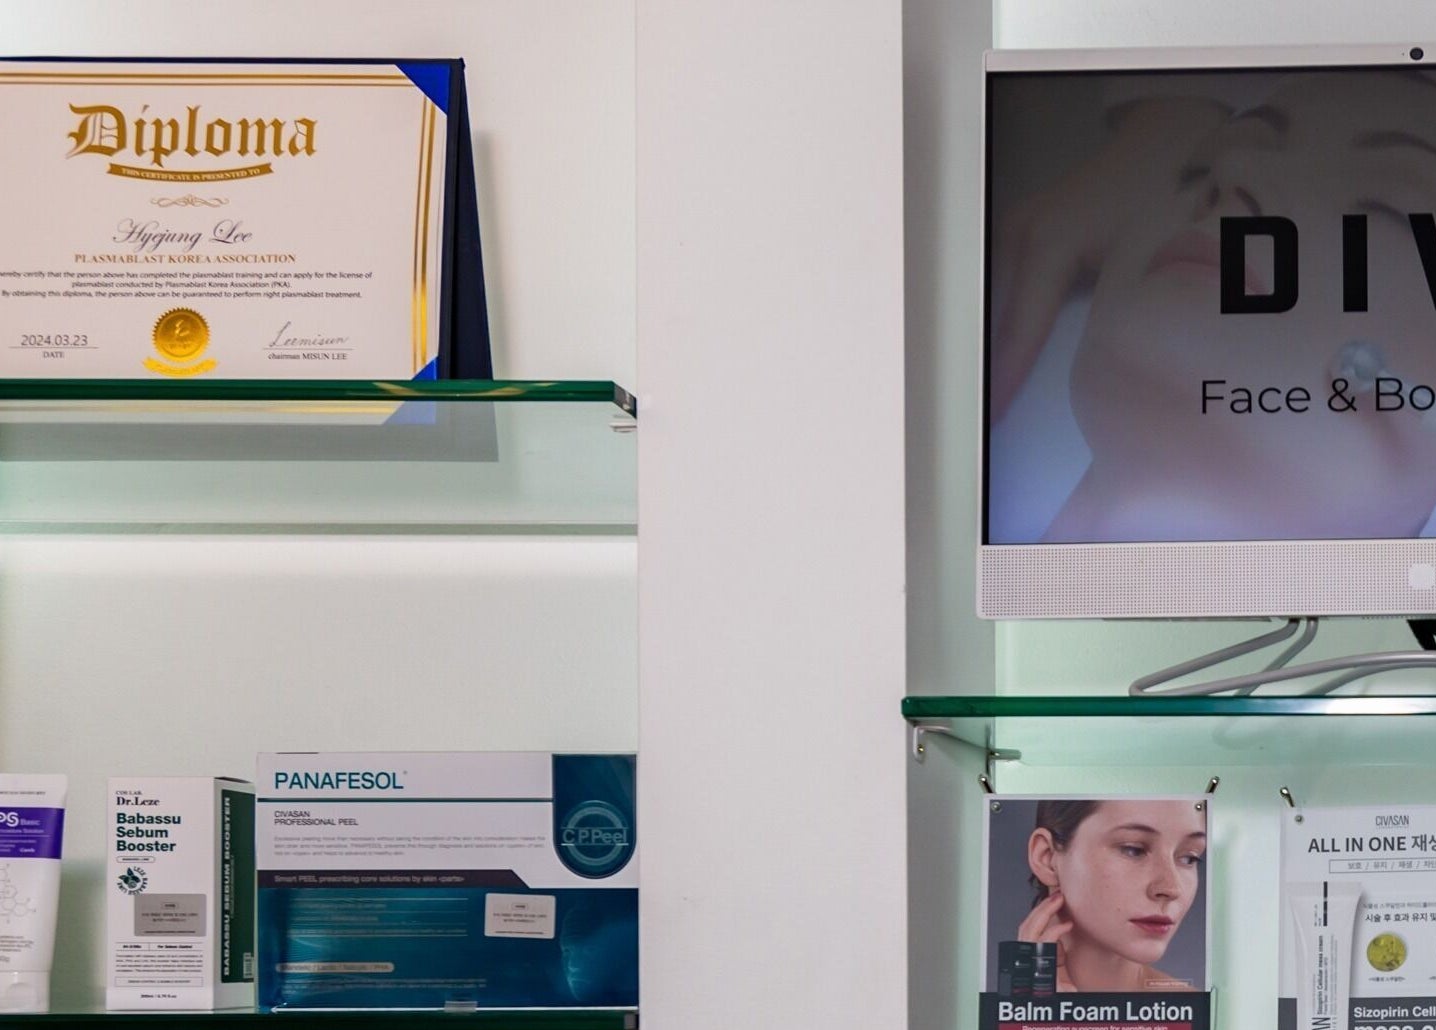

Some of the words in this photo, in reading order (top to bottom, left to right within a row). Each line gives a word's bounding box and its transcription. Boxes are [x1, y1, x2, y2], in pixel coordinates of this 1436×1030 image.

[66, 102, 319, 166] Diploma
[112, 218, 202, 252] Hyejung
[209, 219, 252, 244] Lee
[75, 254, 165, 264] PLASMABLAST
[168, 254, 211, 264] KOREA
[216, 254, 297, 264] ASSOCIATION
[20, 335, 88, 346] 2024.03.23
[43, 351, 64, 359] DATE
[1201, 379, 1310, 414] Face
[1328, 377, 1358, 413] &
[274, 771, 404, 790] PANAFESOL
[116, 796, 160, 806] Dr.Leze
[116, 812, 181, 825] Babassu
[274, 810, 310, 818] CIVASAN
[1376, 815, 1409, 825] CIVASAN
[223, 796, 231, 861] BOOSTER
[274, 818, 336, 826] PROFESSIONAL
[338, 818, 359, 826] PEEL
[116, 826, 168, 838] Sebum
[116, 840, 176, 852] Booster
[1308, 838, 1340, 852] ALL
[1346, 837, 1363, 852] IN
[1368, 836, 1407, 851] ONE
[223, 864, 231, 914] SEBUM
[223, 916, 231, 976] BABASSU
[999, 1002, 1052, 1022] Balm
[1060, 1002, 1119, 1022] Foam
[1126, 1002, 1193, 1021] Lotion
[1354, 1006, 1409, 1020] Sizopirin
